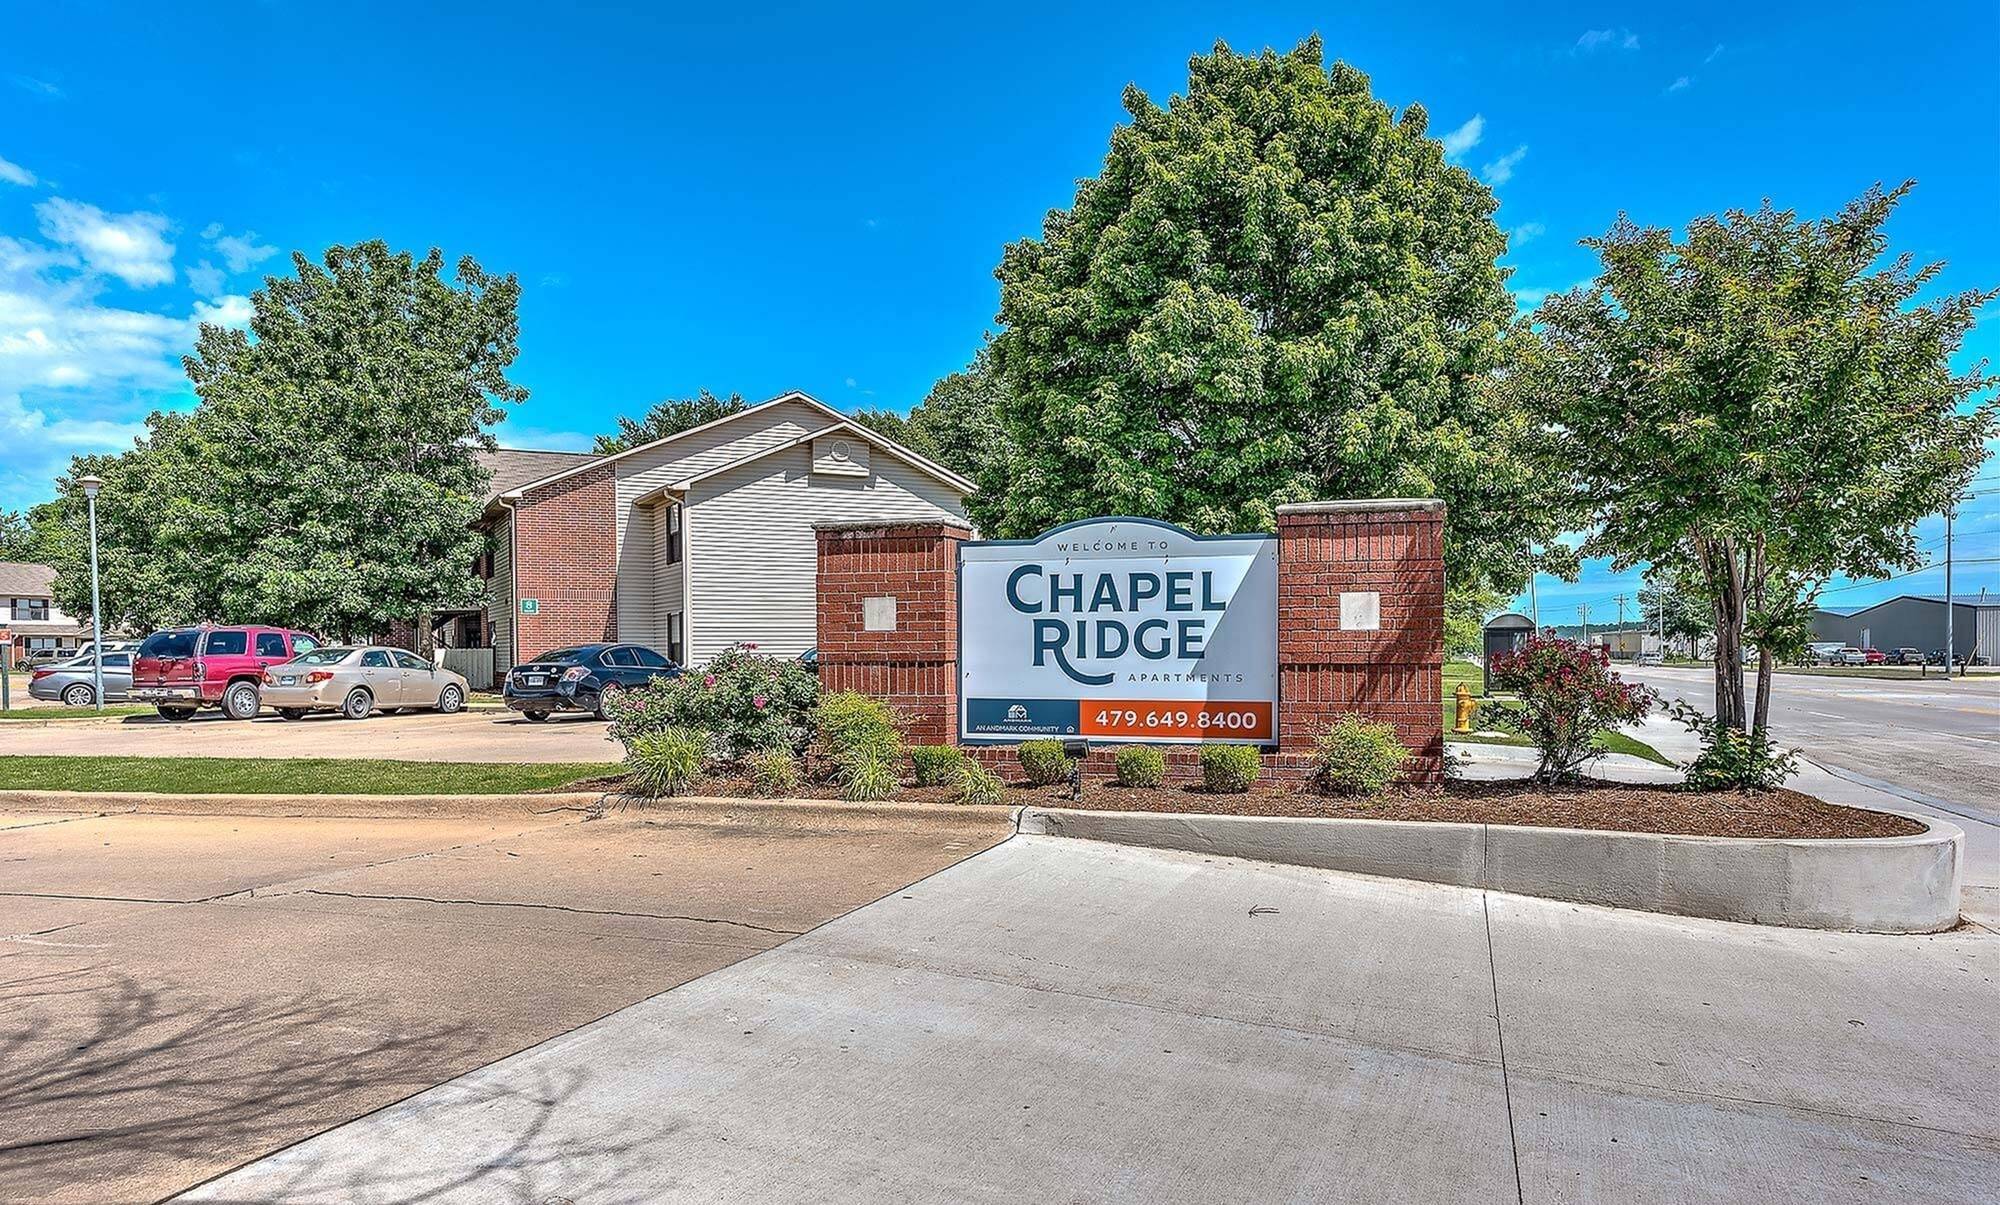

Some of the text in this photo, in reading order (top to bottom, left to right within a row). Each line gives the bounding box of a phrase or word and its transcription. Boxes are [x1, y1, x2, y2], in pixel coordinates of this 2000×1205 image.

[1057, 540, 1168, 552] WELCOME TO
[1006, 564, 1227, 614] CHAPEL
[1032, 618, 1206, 686] RIDGE
[1128, 673, 1244, 683] APARTMENTS
[1095, 710, 1257, 729] 479.649.8400
[986, 725, 1018, 733] ANDMARK
[1018, 725, 1060, 733] COMMUNITY
